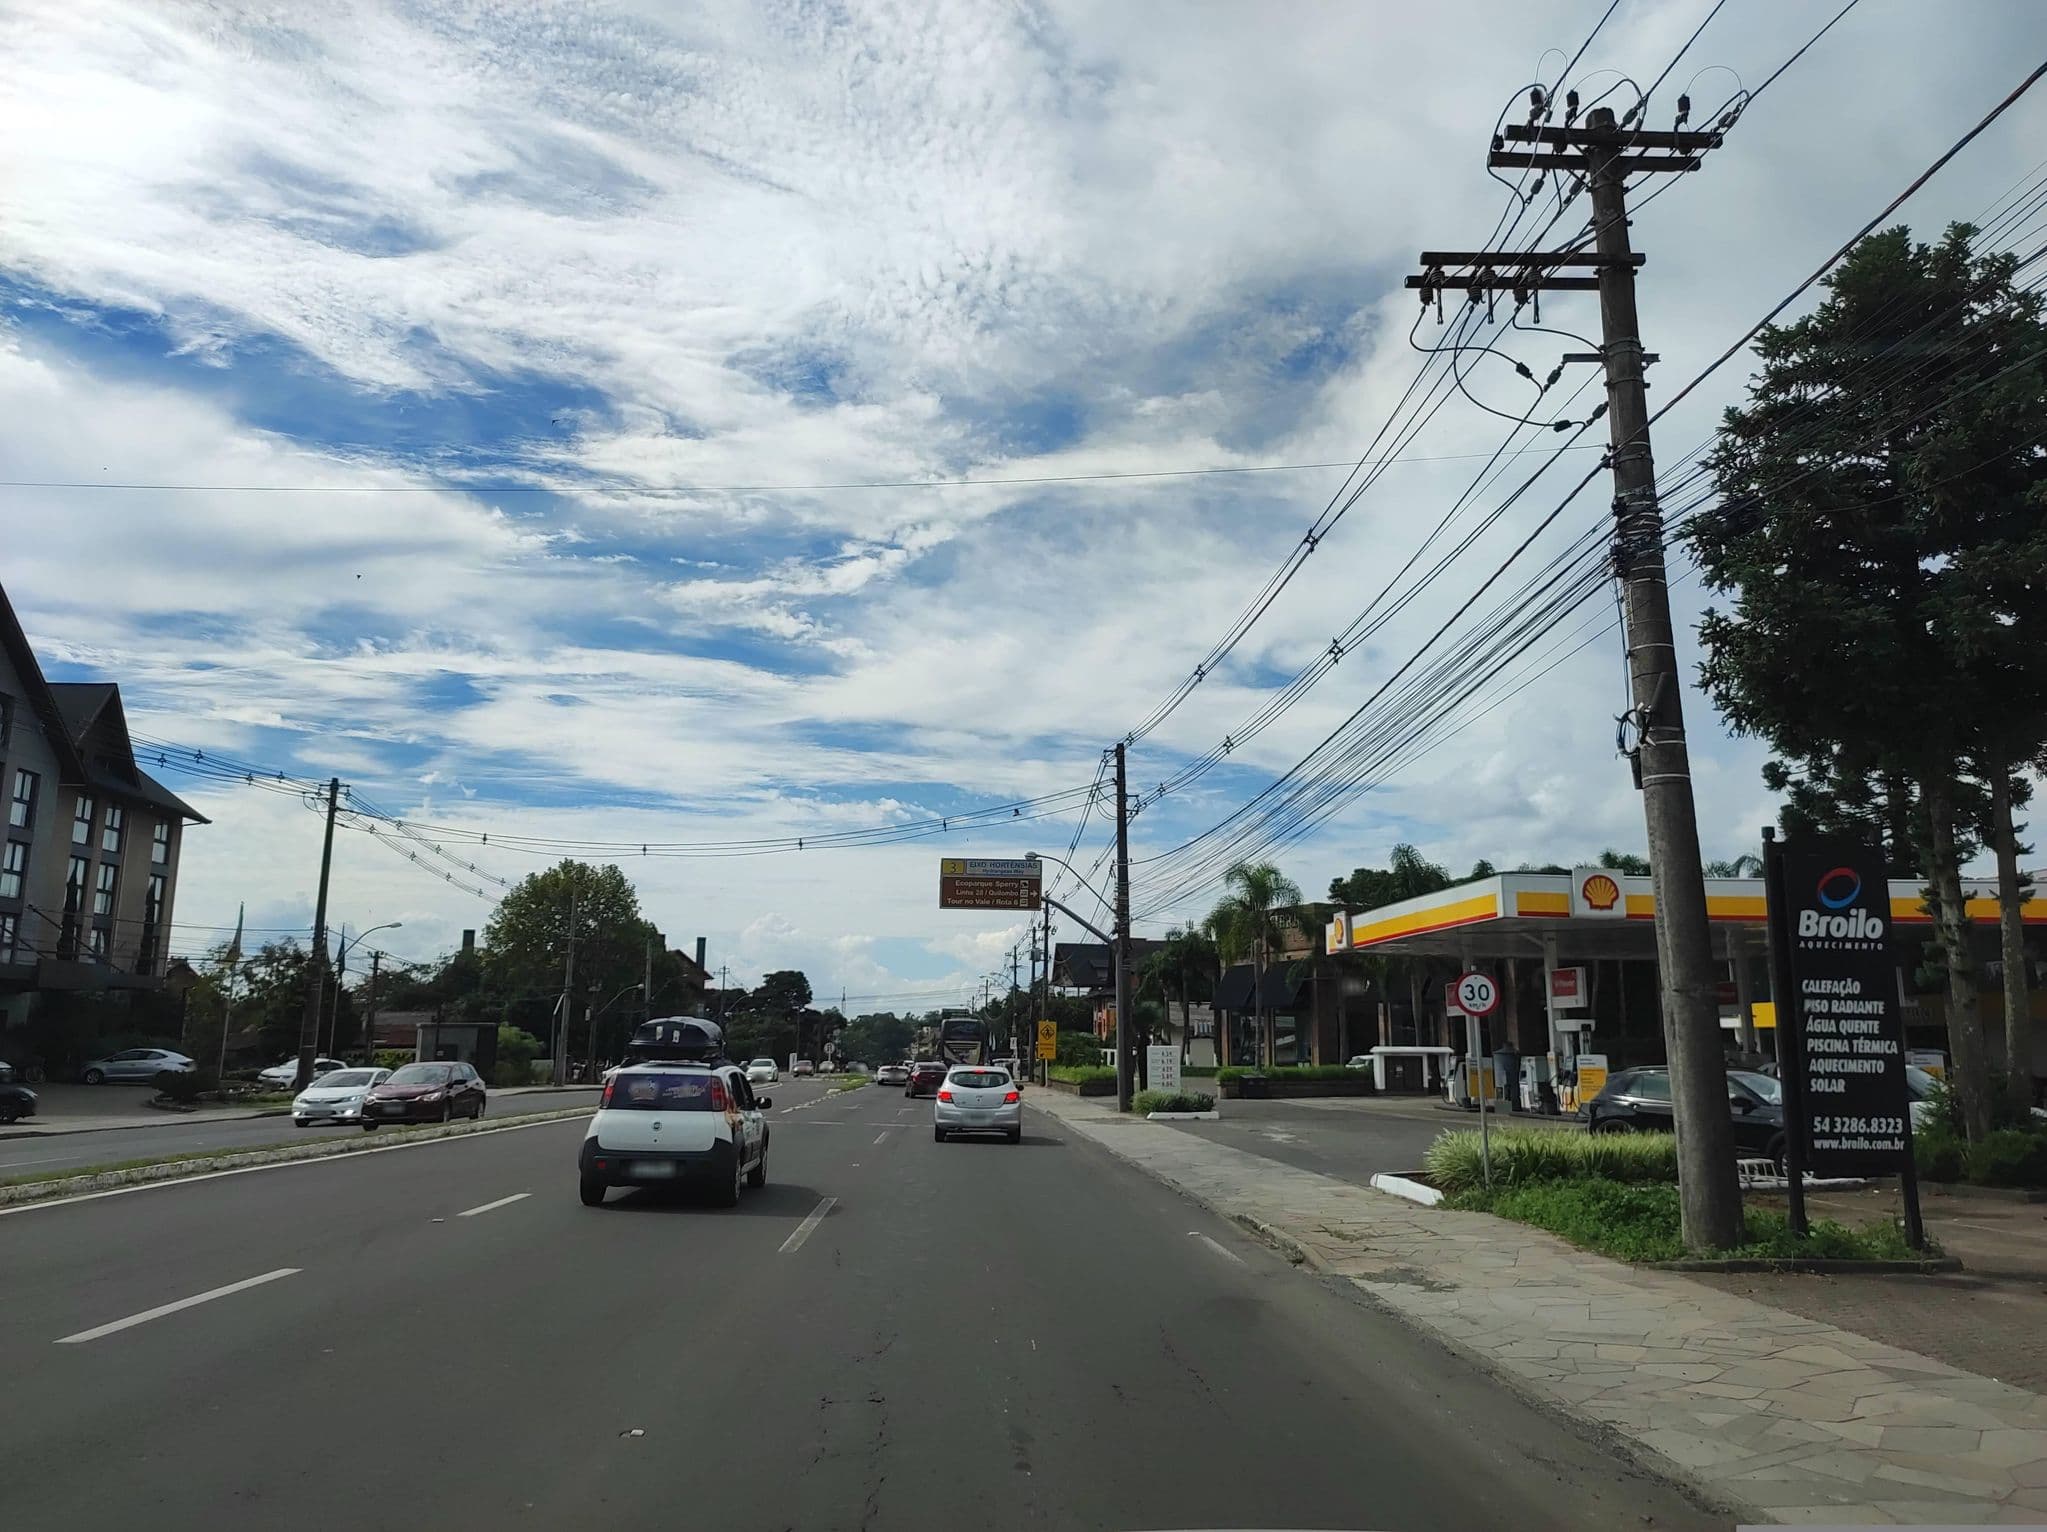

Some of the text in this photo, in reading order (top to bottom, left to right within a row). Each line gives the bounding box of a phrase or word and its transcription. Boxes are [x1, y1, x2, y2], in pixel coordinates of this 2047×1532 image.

[950, 862, 957, 873] 3
[955, 880, 993, 888] Ecoparque
[1798, 908, 1884, 939] Broilo
[1799, 941, 1884, 951] AQUECIMENTO
[1464, 984, 1490, 1001] 30
[1802, 978, 1861, 997] CALEFAÇÃO
[1803, 999, 1885, 1015] PISO RADIANTE
[1806, 1015, 1880, 1036] ÁGUA QUENTE
[1807, 1036, 1898, 1055] PISCINA TÉRMICA
[1809, 1058, 1885, 1074] AQUECIMENTO
[1810, 1078, 1846, 1093] SOLAR
[1813, 1116, 1903, 1134] 54 3286.8323
[1813, 1136, 1905, 1151] www.broilo.com.br
